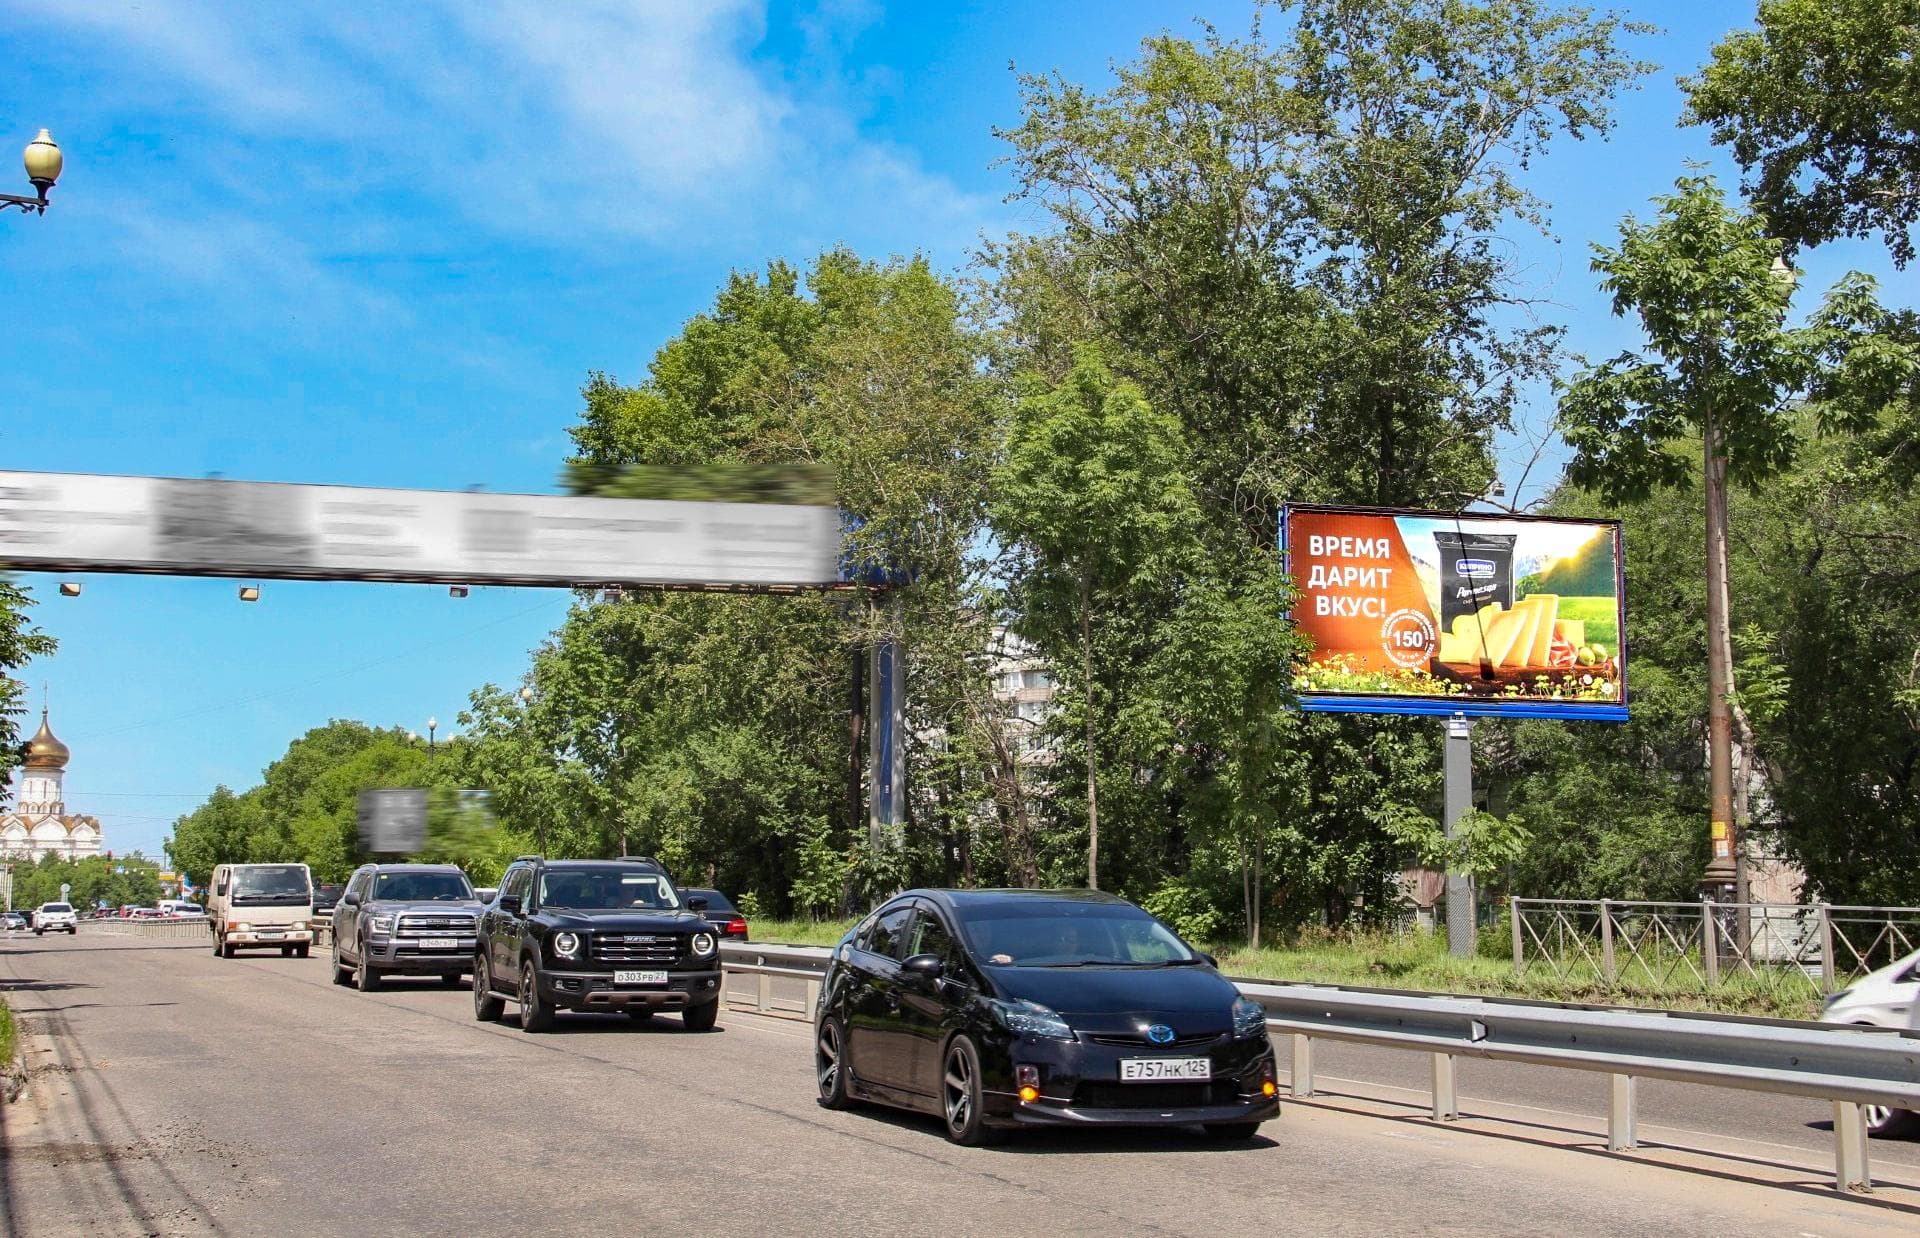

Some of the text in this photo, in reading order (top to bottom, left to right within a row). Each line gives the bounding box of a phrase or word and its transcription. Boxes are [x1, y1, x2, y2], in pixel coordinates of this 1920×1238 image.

[1309, 535, 1390, 559] ВРЕМЯ
[1307, 565, 1392, 589] ДАРИТ
[1316, 595, 1387, 618] ВКУС!
[1393, 630, 1423, 648] 150
[1185, 1060, 1207, 1072] 125
